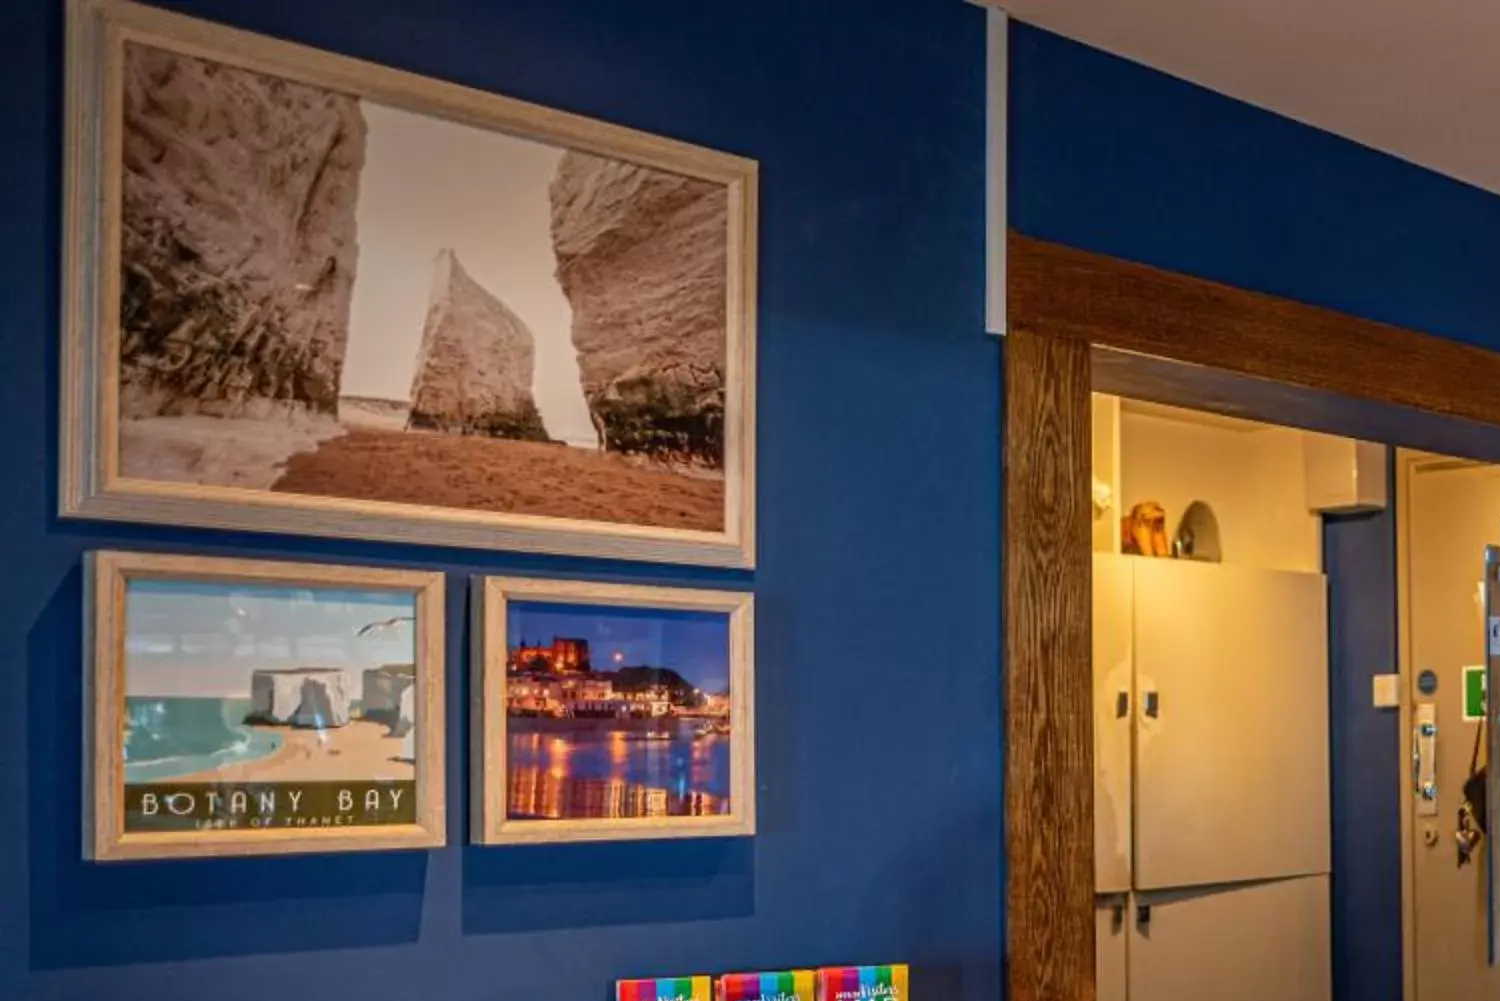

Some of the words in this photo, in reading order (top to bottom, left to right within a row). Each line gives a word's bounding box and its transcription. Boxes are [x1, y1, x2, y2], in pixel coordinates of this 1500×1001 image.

[141, 790, 303, 816] BOTANY
[338, 789, 403, 812] BAY
[250, 816, 273, 827] OF
[286, 815, 355, 828] THANET
